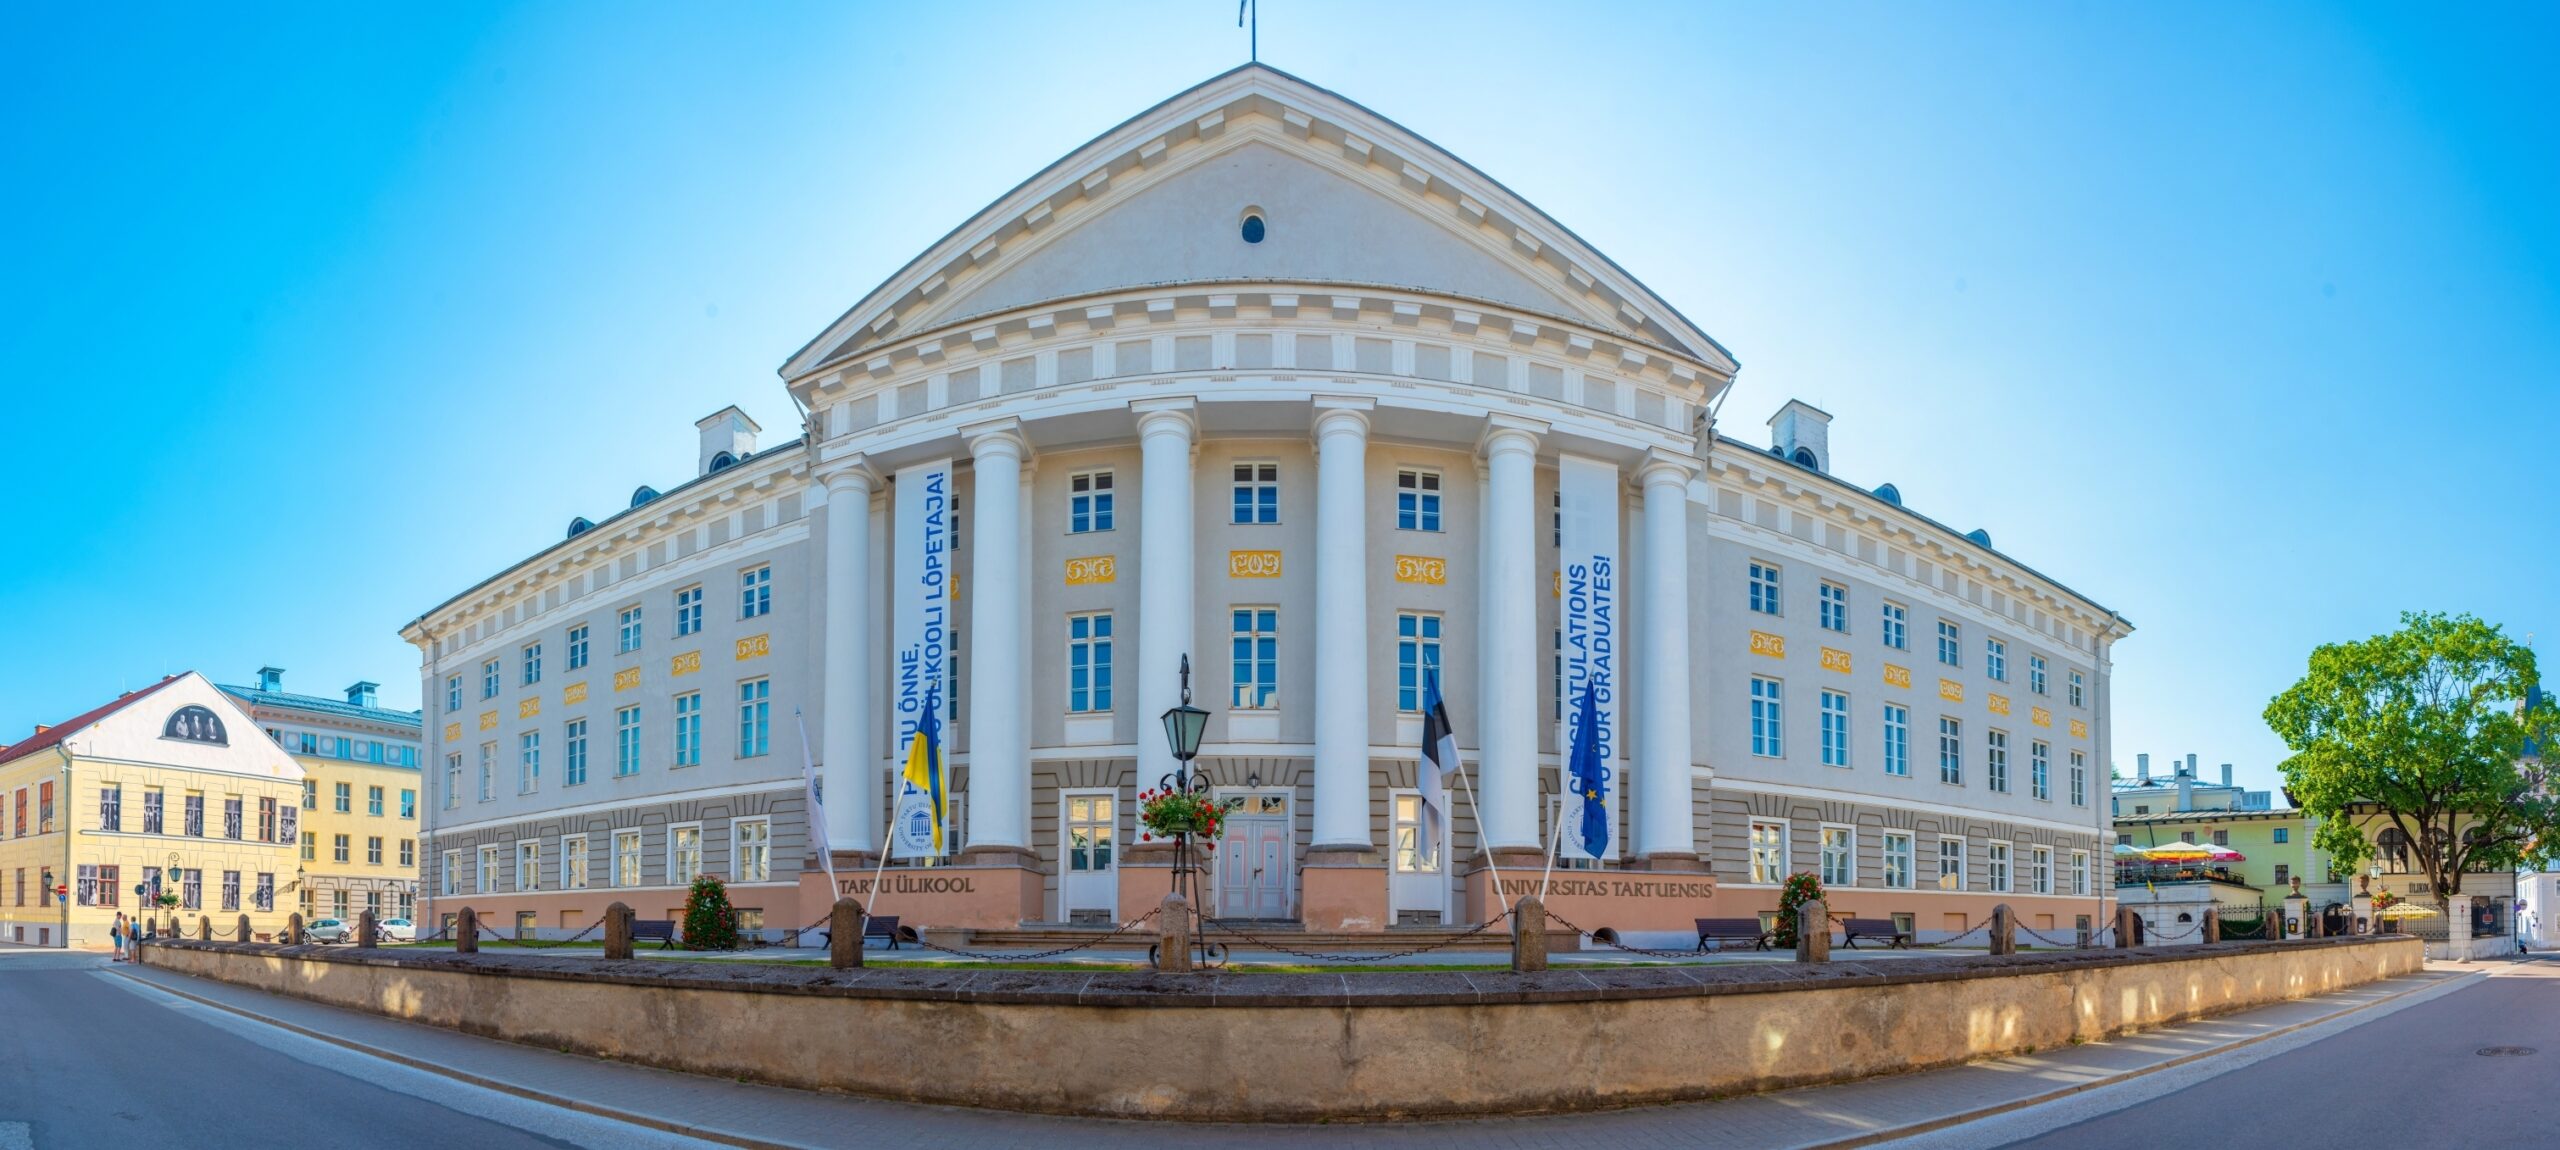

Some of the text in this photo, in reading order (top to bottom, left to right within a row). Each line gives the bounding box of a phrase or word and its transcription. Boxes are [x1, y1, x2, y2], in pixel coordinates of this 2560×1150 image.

[922, 472, 944, 600] LÕPETAJA!
[1593, 555, 1611, 704] GRADUATES!
[898, 643, 920, 795] PJU ÕNNE,
[896, 875, 975, 893] ÜLIKOOL
[1492, 879, 1713, 898] UNIVERSITAS TARTUENSIS
